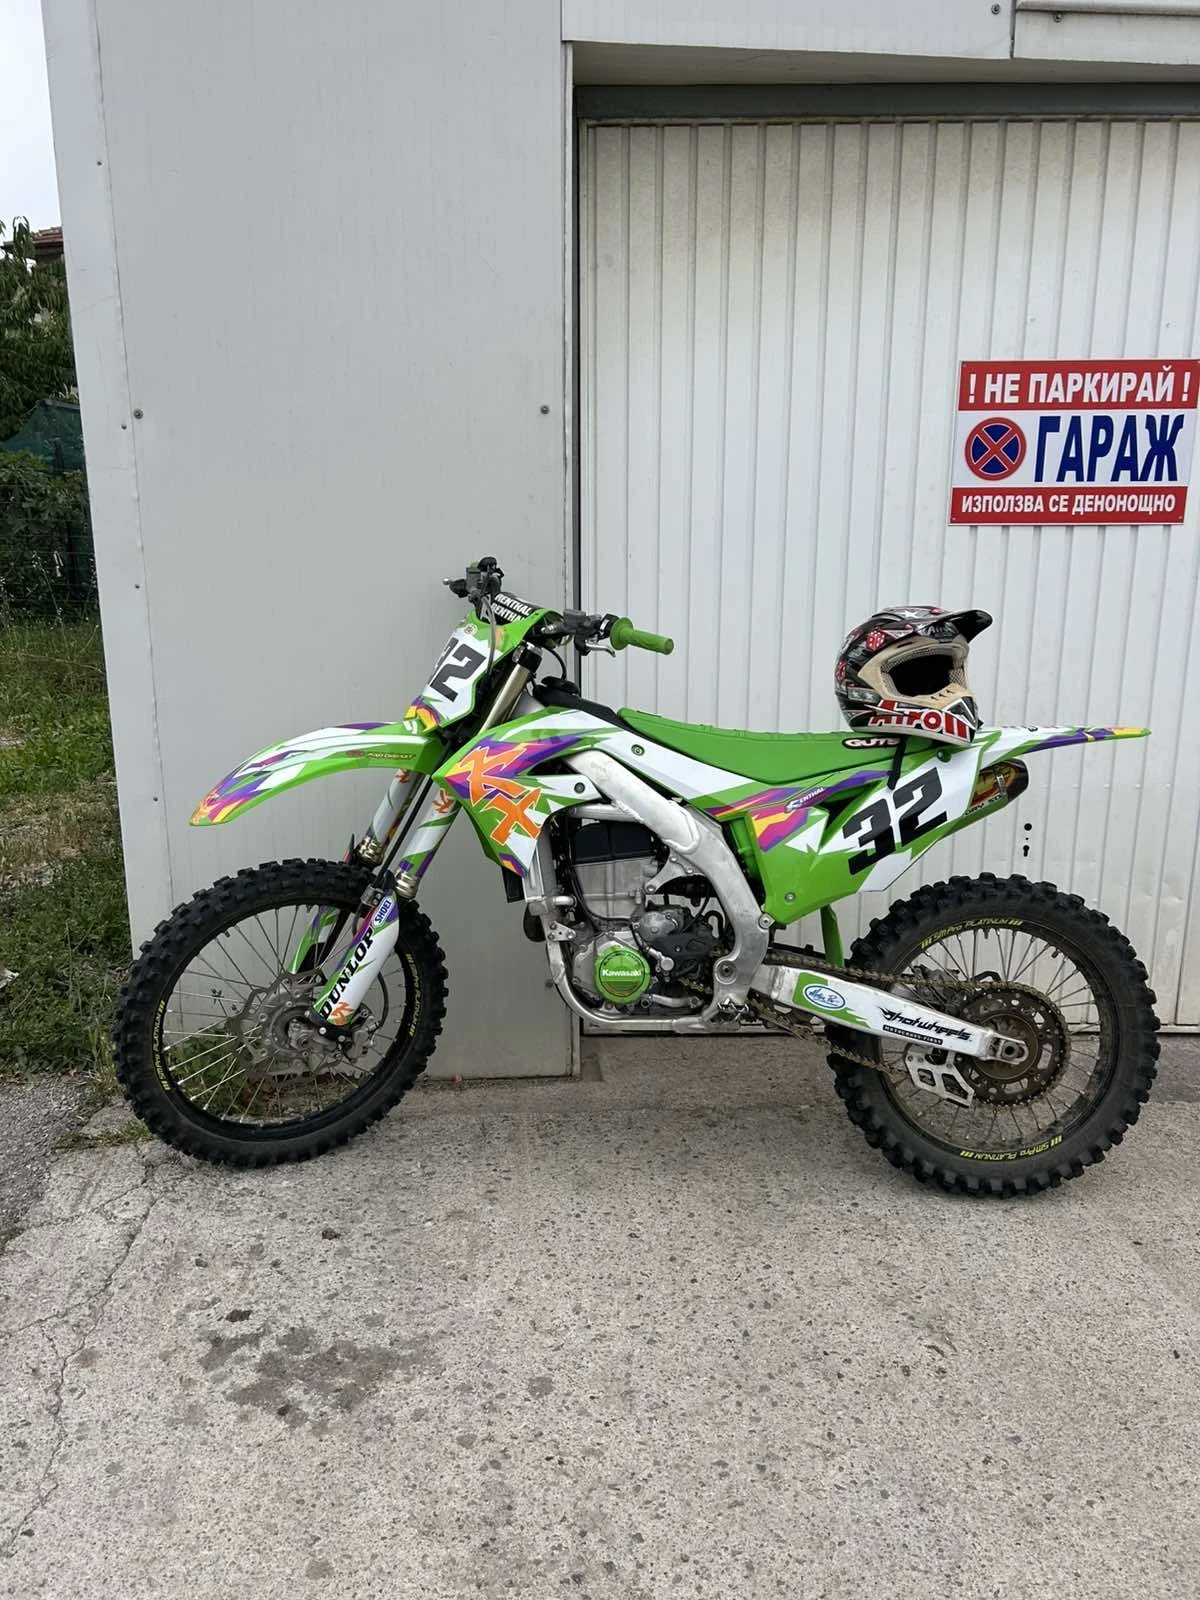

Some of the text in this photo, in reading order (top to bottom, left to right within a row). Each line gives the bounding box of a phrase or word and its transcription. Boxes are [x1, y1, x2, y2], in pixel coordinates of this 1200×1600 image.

[984, 373, 1021, 403] НЕ
[1028, 365, 1175, 403] ПАРКИРАЙ
[1034, 414, 1185, 482] ГАРАЖ
[961, 494, 1176, 515] ИЗПОЛЗВА СЕ ДЕНОНОЩНО
[458, 744, 543, 847] KX
[842, 767, 947, 875] 32
[375, 899, 392, 924] SHOEI
[320, 927, 375, 1020] DUNLOP
[602, 969, 642, 977] Kawasaki
